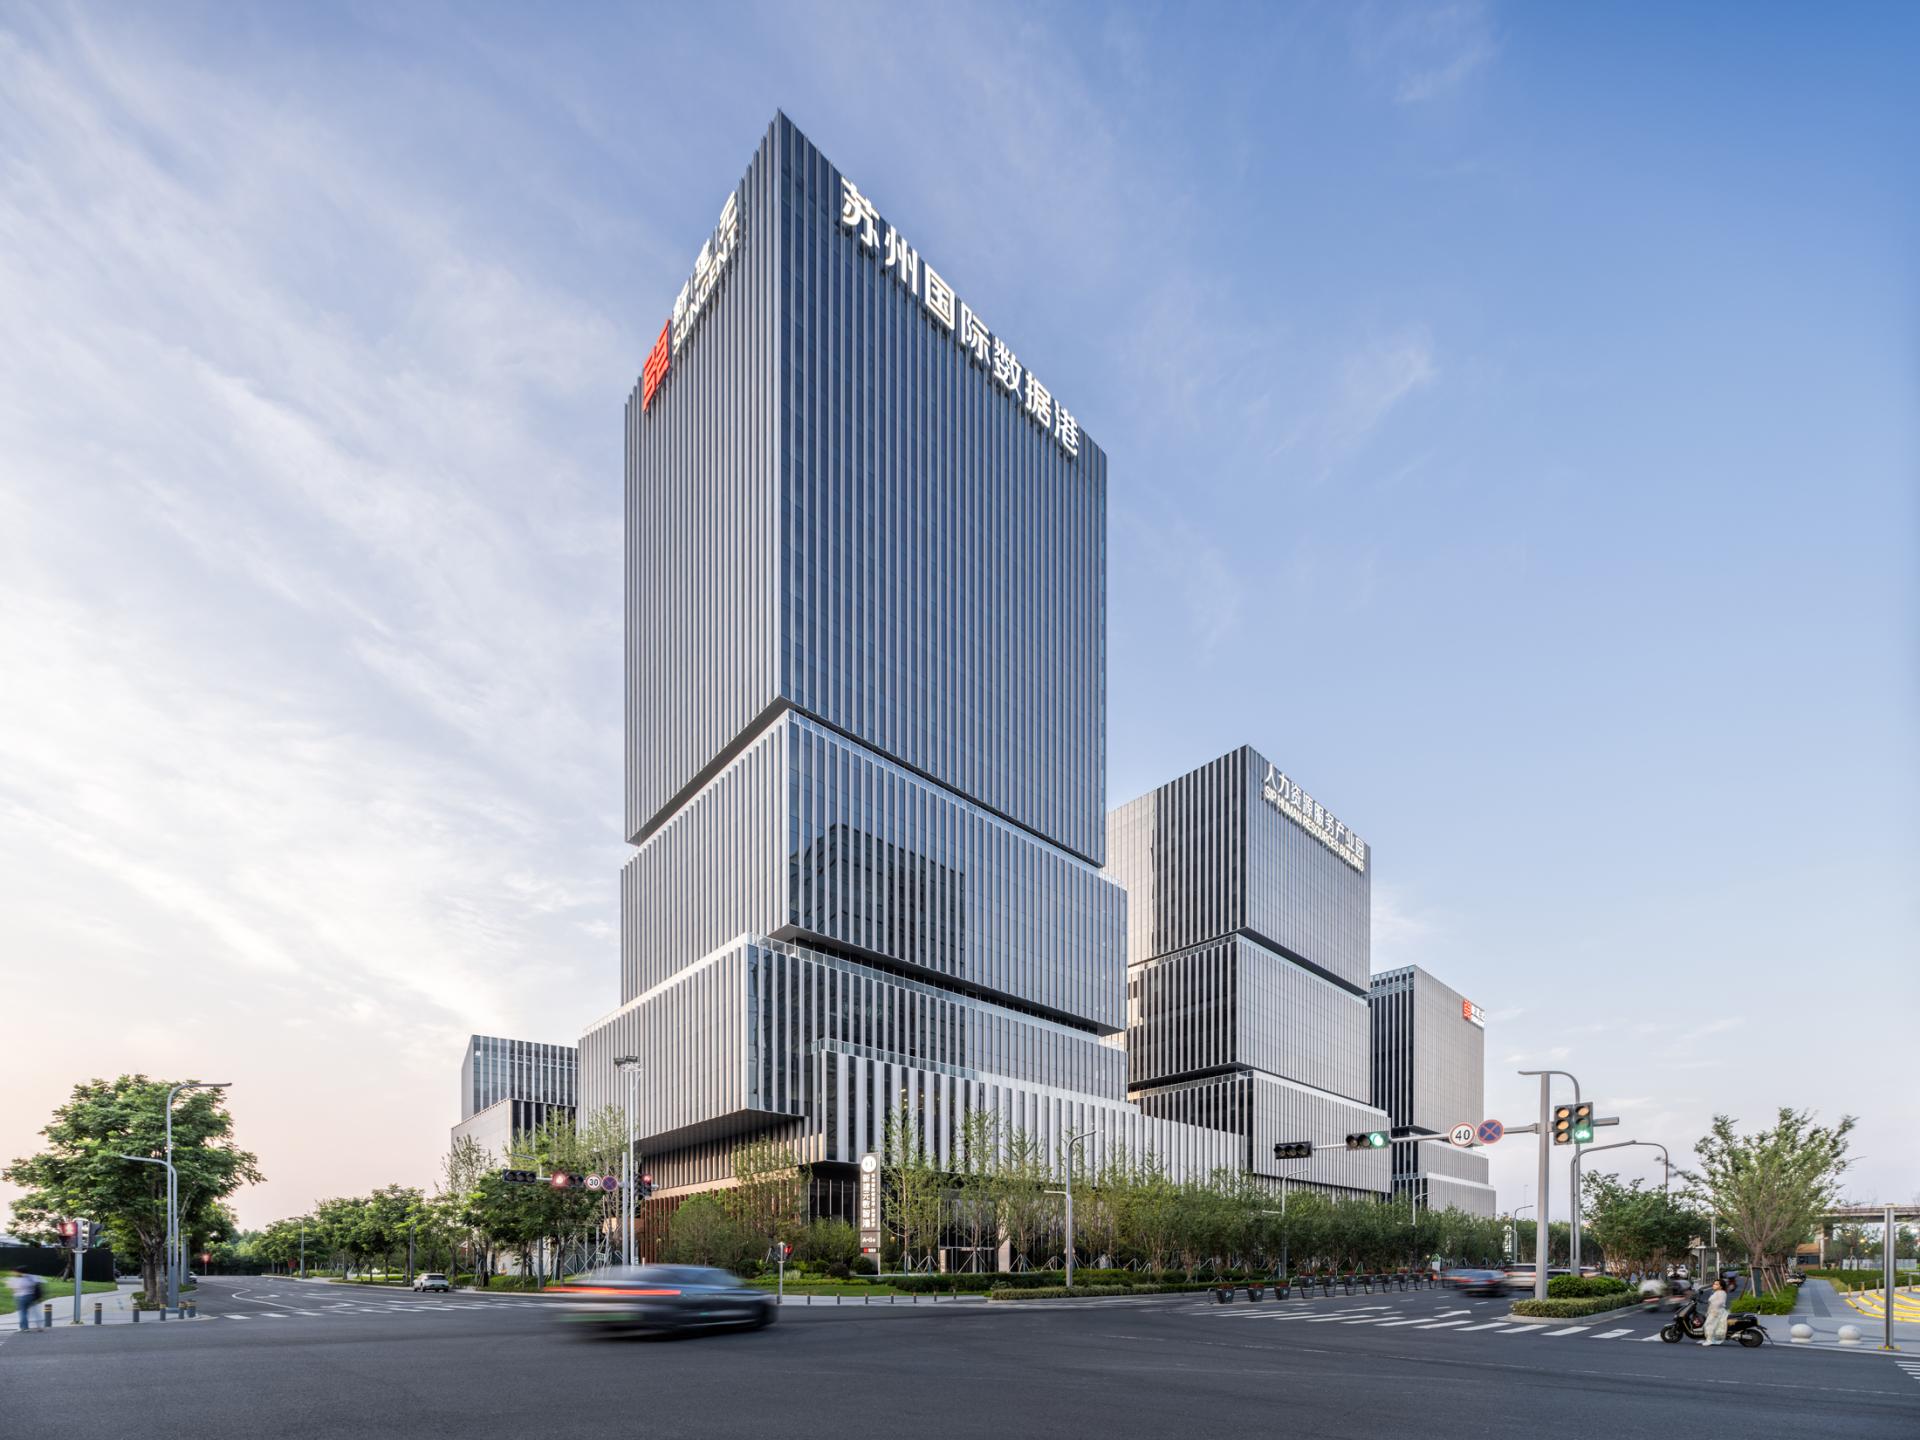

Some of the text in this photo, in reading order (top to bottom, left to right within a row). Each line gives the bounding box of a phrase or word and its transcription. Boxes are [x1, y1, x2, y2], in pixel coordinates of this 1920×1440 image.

[673, 191, 738, 328] 新建元
[673, 223, 738, 355] SUNGENT
[841, 177, 1079, 457] 苏州国际数据港
[1265, 764, 1364, 860] 人力资源服务产业园
[1277, 795, 1302, 823] HUMAN
[1302, 815, 1338, 852] RESOURCES
[589, 1178, 599, 1186] 30
[1455, 1129, 1470, 1141] 40
